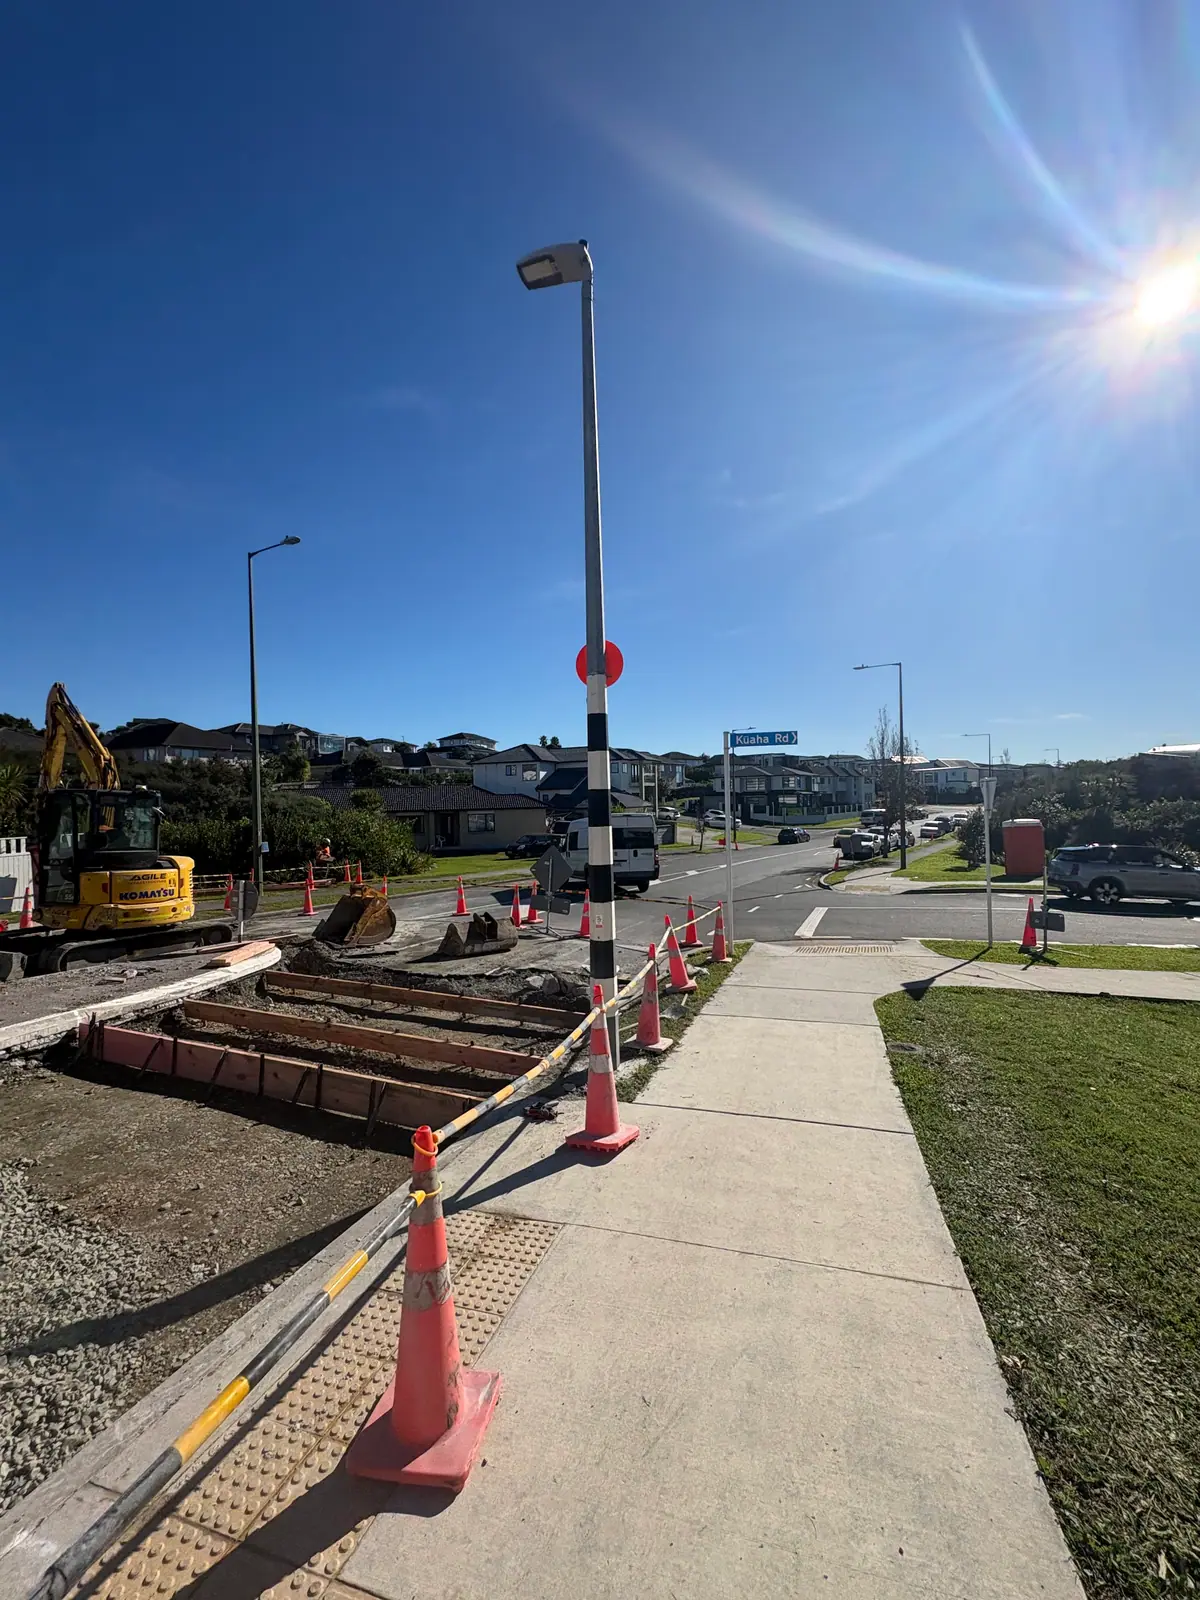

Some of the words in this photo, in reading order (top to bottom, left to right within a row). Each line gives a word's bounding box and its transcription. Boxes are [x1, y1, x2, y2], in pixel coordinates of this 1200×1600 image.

[736, 734, 769, 744] Kūaha
[775, 733, 789, 743] Rd
[130, 873, 167, 881] AGILE
[119, 888, 175, 900] KOMATSU
